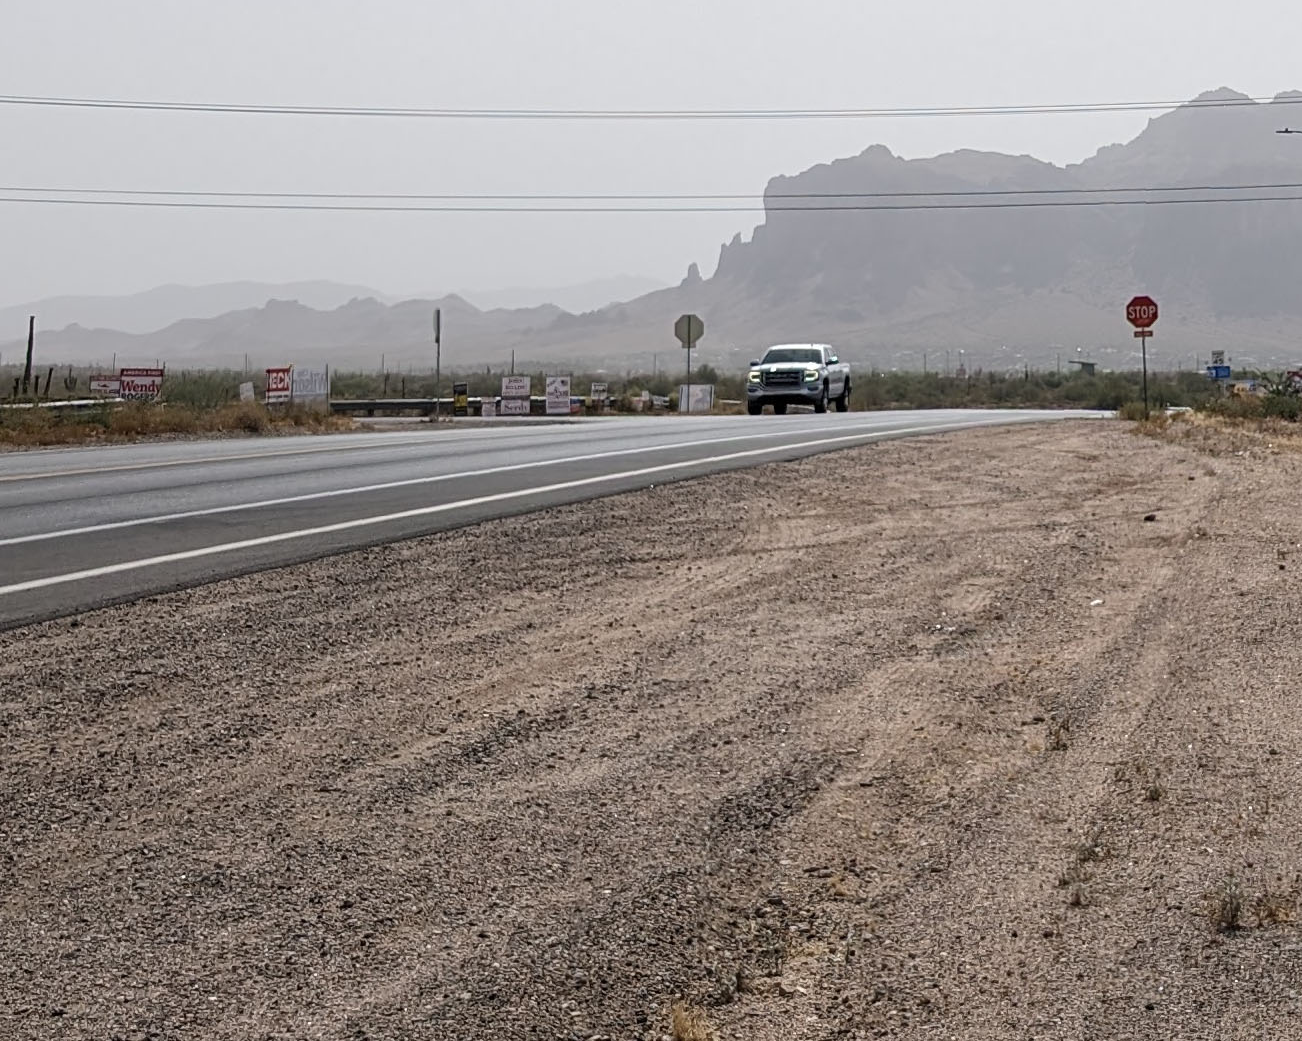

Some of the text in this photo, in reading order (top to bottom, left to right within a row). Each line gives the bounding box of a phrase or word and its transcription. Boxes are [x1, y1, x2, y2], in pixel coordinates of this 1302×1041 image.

[1128, 305, 1156, 319] STOP
[121, 380, 161, 397] Wendy
[121, 393, 156, 401] ROGERS
